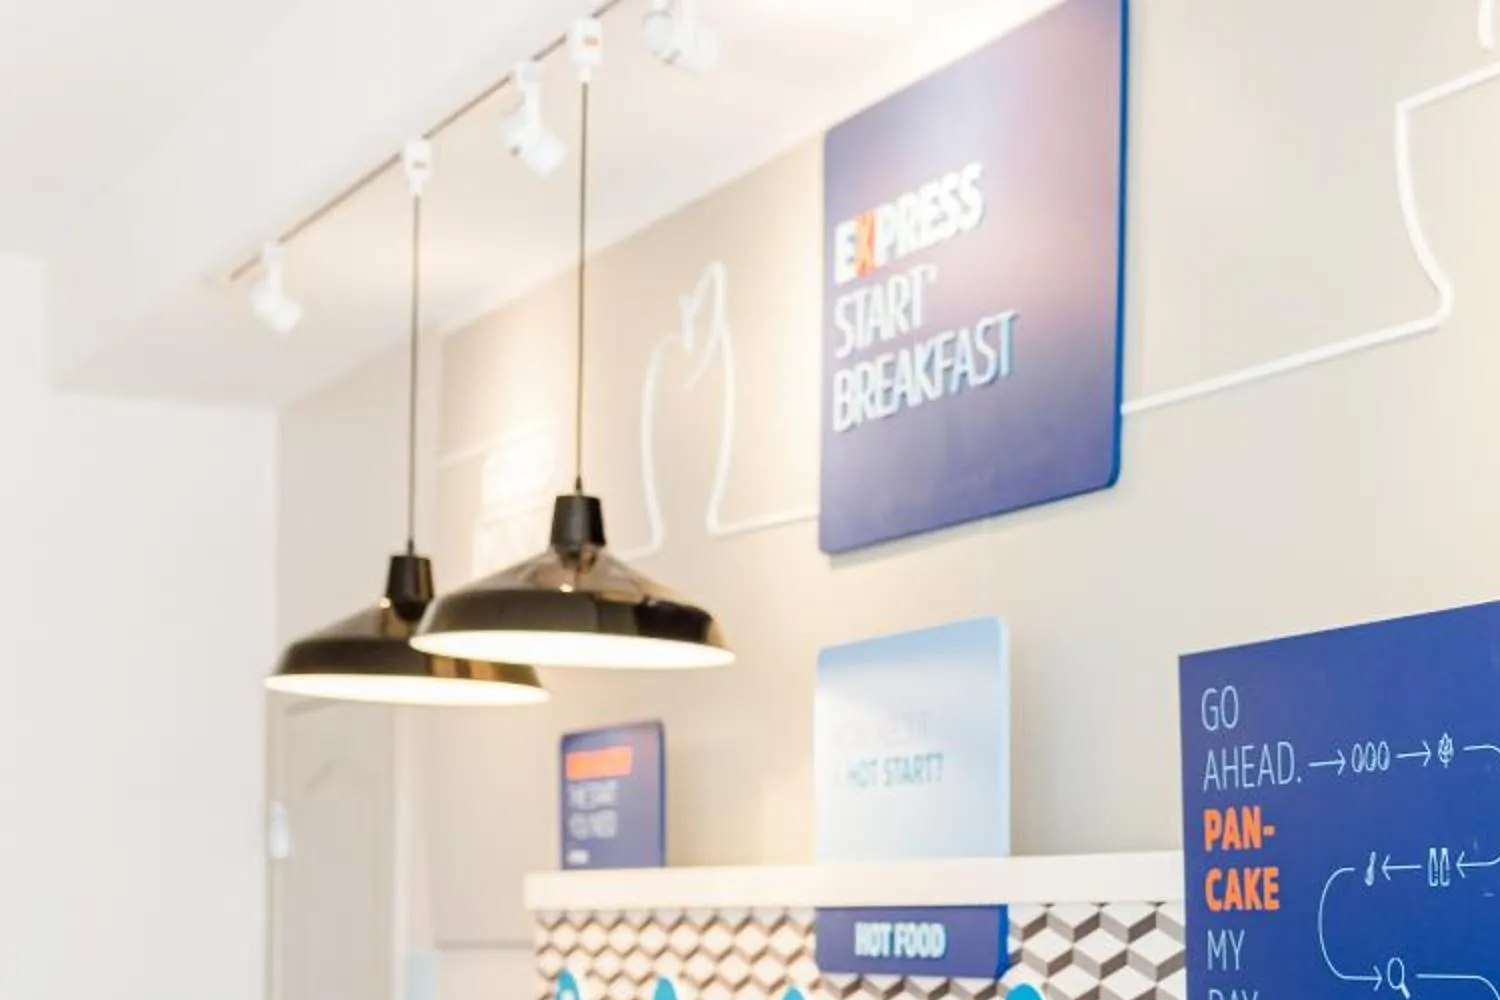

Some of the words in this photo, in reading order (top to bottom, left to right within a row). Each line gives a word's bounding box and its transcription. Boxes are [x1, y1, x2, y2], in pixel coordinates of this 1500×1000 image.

[834, 163, 986, 285] EXPRESS
[834, 266, 933, 359] START
[832, 309, 1020, 433] BREAKFAST
[1201, 686, 1239, 731] GO
[1203, 741, 1302, 791] AHEAD.
[1204, 805, 1276, 851] PAN-
[1204, 866, 1280, 911] CAKE
[854, 922, 891, 958] HOT
[893, 922, 946, 958] FOOD
[1207, 929, 1246, 971] MY
